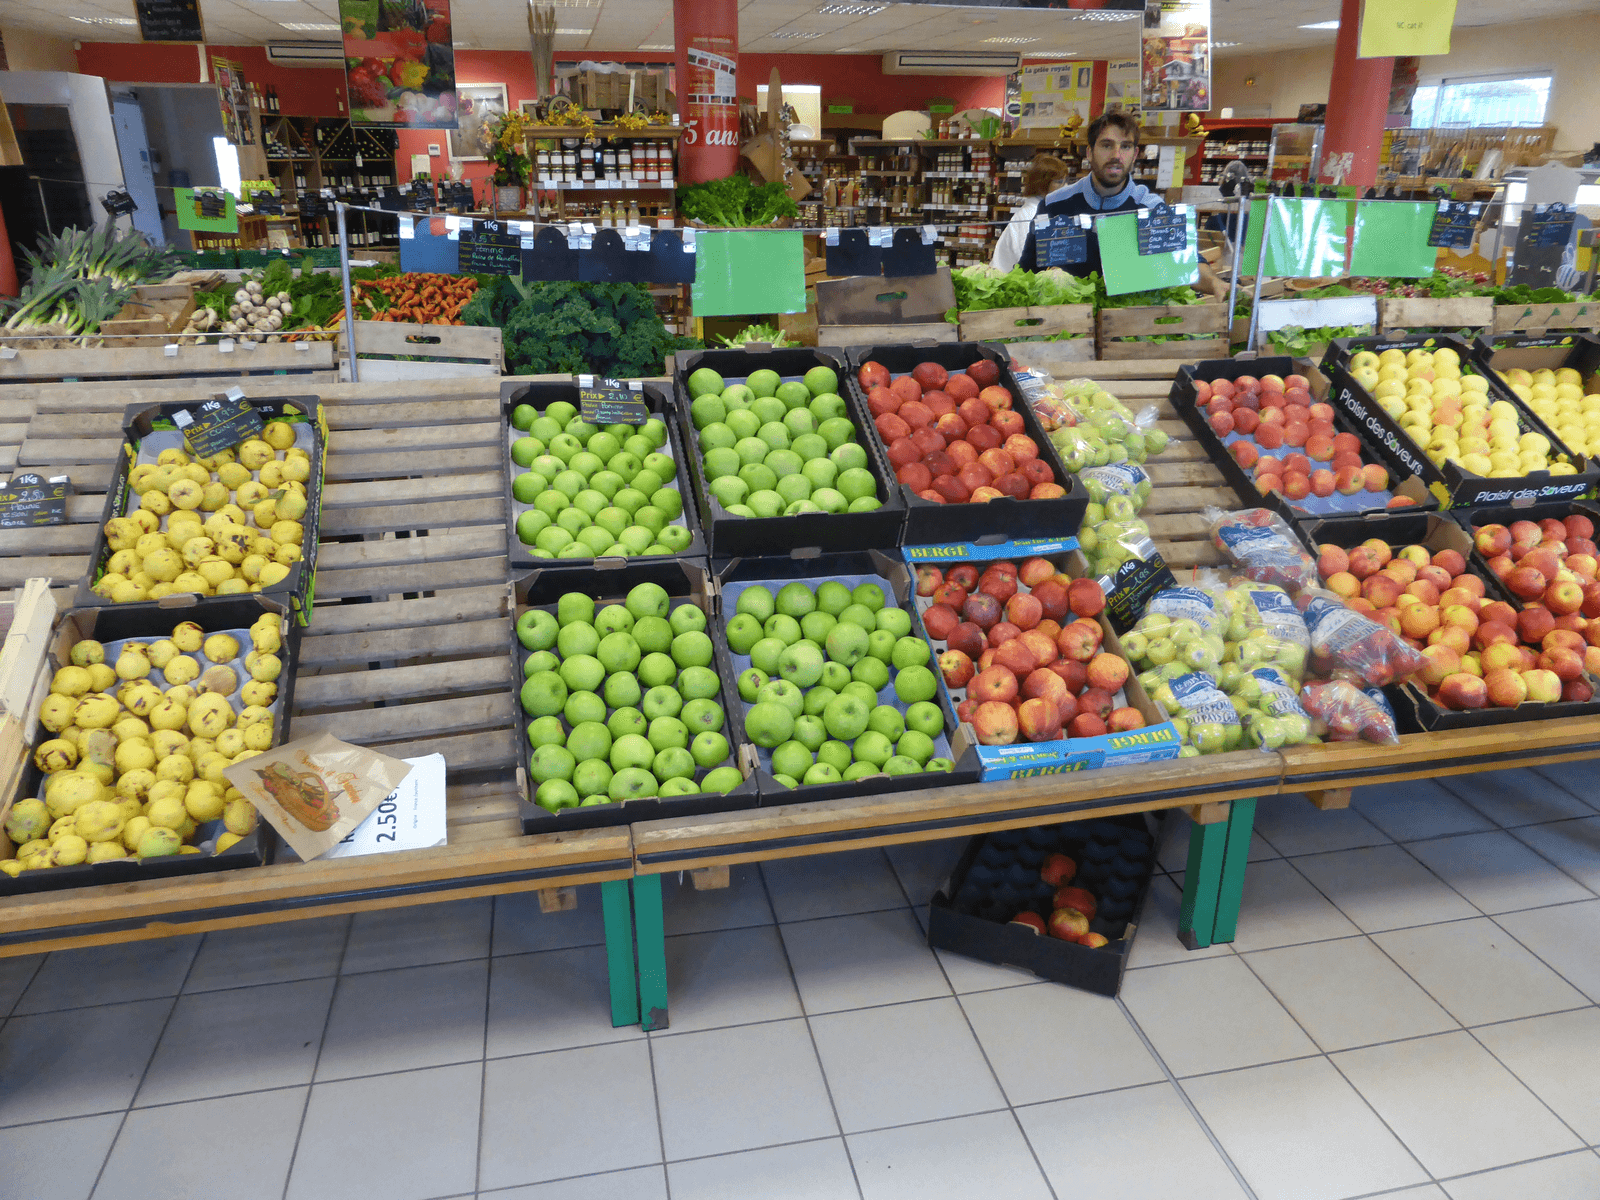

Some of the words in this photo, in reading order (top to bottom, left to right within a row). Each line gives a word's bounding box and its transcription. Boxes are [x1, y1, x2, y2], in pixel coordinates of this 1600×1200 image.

[684, 119, 698, 145] 5
[705, 129, 739, 146] ans
[483, 221, 499, 231] 1Kg
[605, 378, 620, 389] 1Kg
[580, 390, 599, 400] Prix
[202, 400, 222, 412] 1Kg
[183, 422, 205, 438] Prix
[1339, 388, 1369, 421] Plaisir
[1366, 416, 1386, 440] des
[1384, 431, 1423, 476] Saveurs
[19, 474, 39, 485] 1Kg
[52, 486, 65, 498] €
[1474, 489, 1514, 503] Plaisir
[1513, 488, 1540, 499] des
[1538, 483, 1588, 498] Saveurs
[1119, 561, 1136, 576] 1Kg
[1107, 590, 1126, 607] Prix
